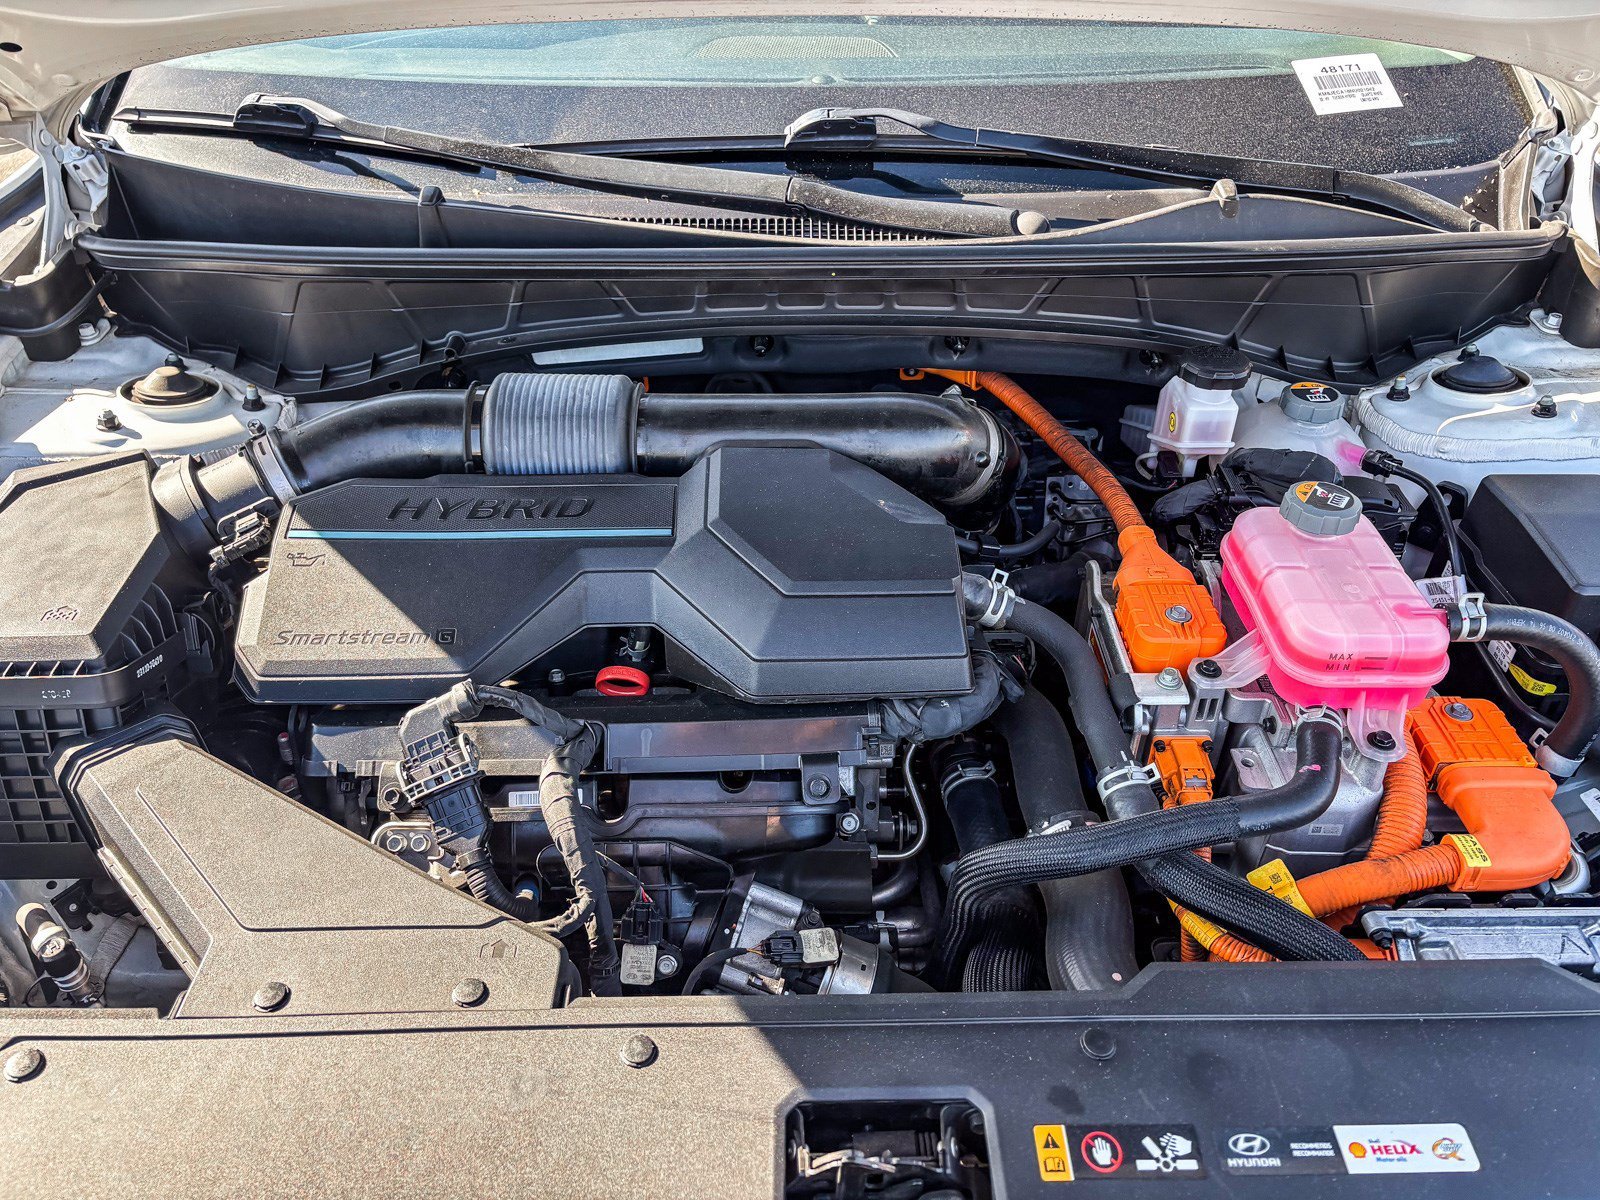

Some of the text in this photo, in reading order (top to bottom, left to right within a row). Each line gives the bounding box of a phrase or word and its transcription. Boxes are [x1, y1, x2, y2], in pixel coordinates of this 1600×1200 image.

[1320, 63, 1361, 74] 48171
[386, 496, 596, 521] HYBRID
[273, 629, 454, 646] Smartstream G
[1328, 653, 1354, 661] MAX
[1325, 663, 1351, 671] MIN
[1370, 1143, 1424, 1155] HELIX
[1226, 1157, 1282, 1168] HYUNDAI
